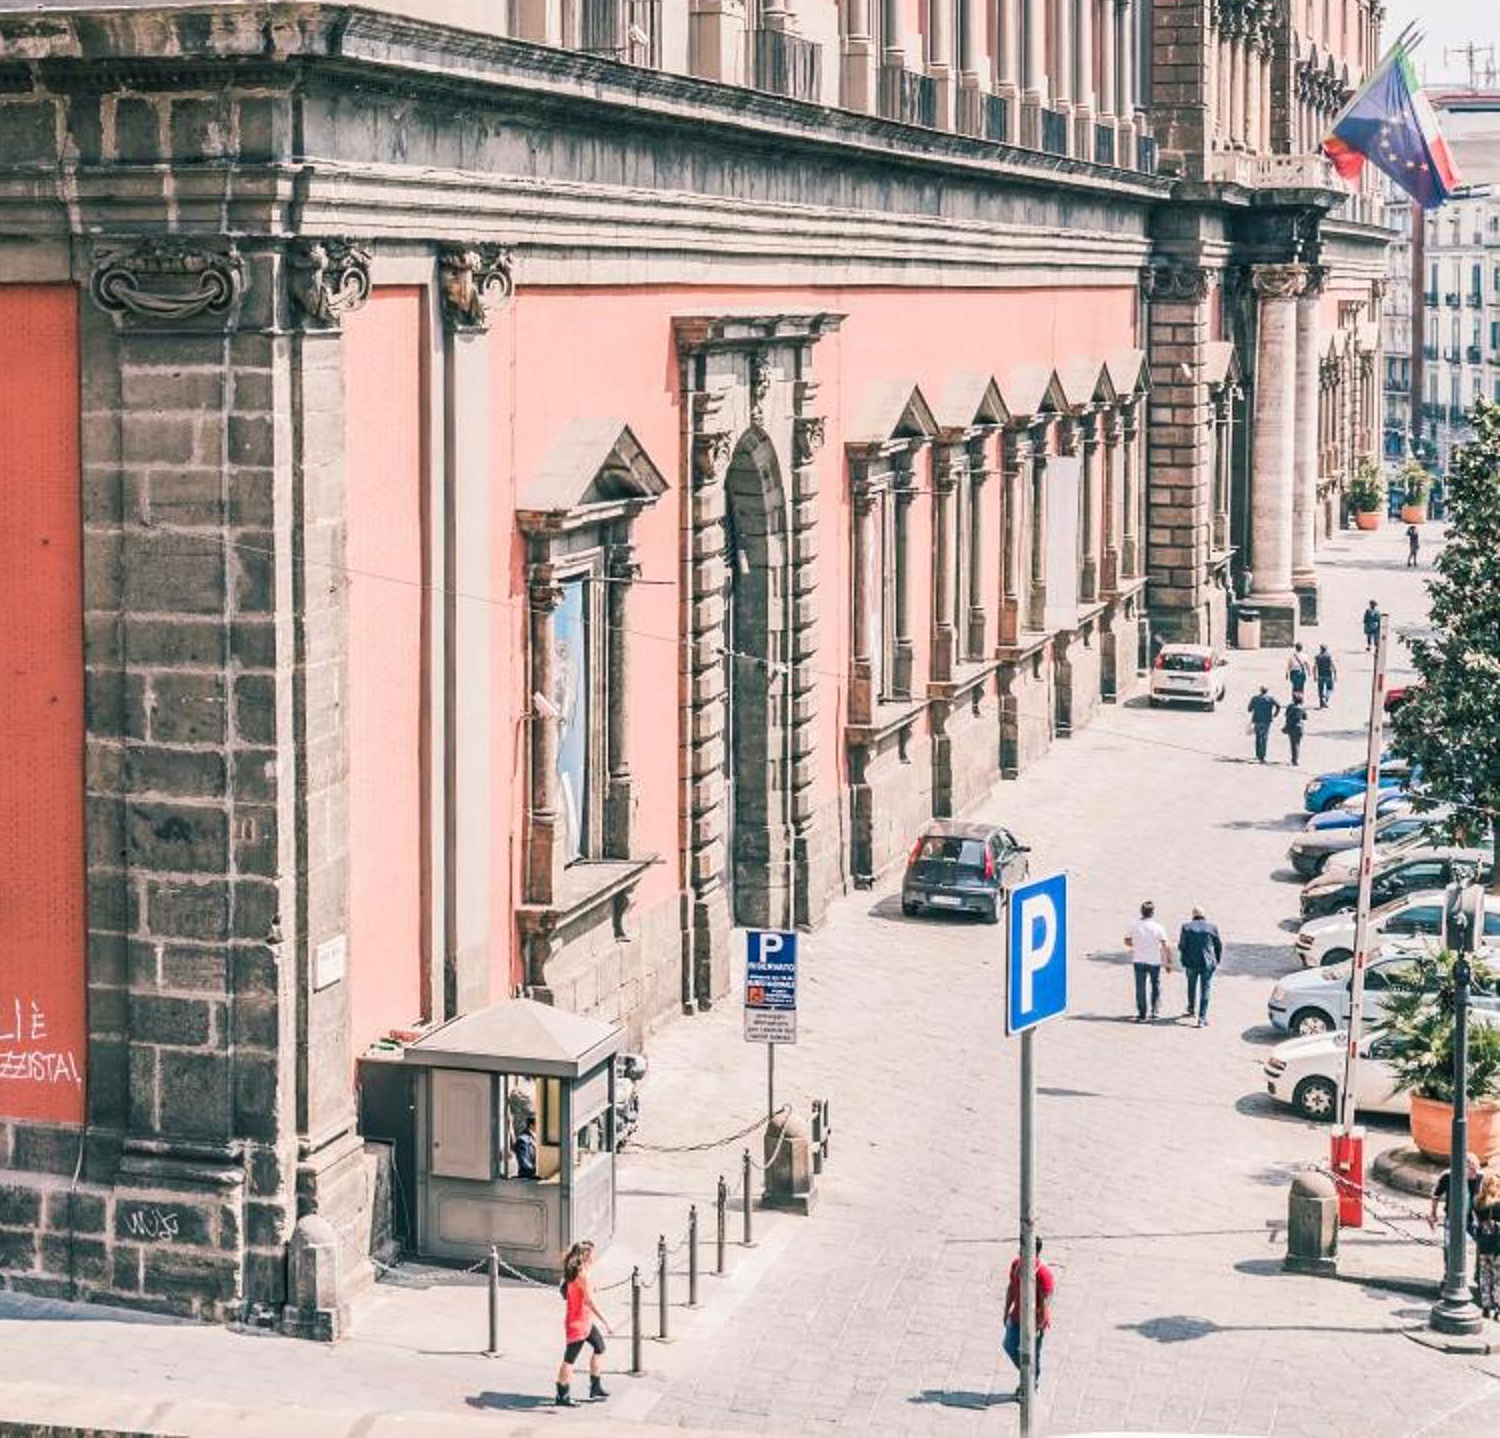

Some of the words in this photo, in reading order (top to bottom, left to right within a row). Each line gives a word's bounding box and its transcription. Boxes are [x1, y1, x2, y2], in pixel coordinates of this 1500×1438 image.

[760, 933, 783, 962] P
[1021, 893, 1056, 1015] P
[31, 1000, 48, 1041] È
